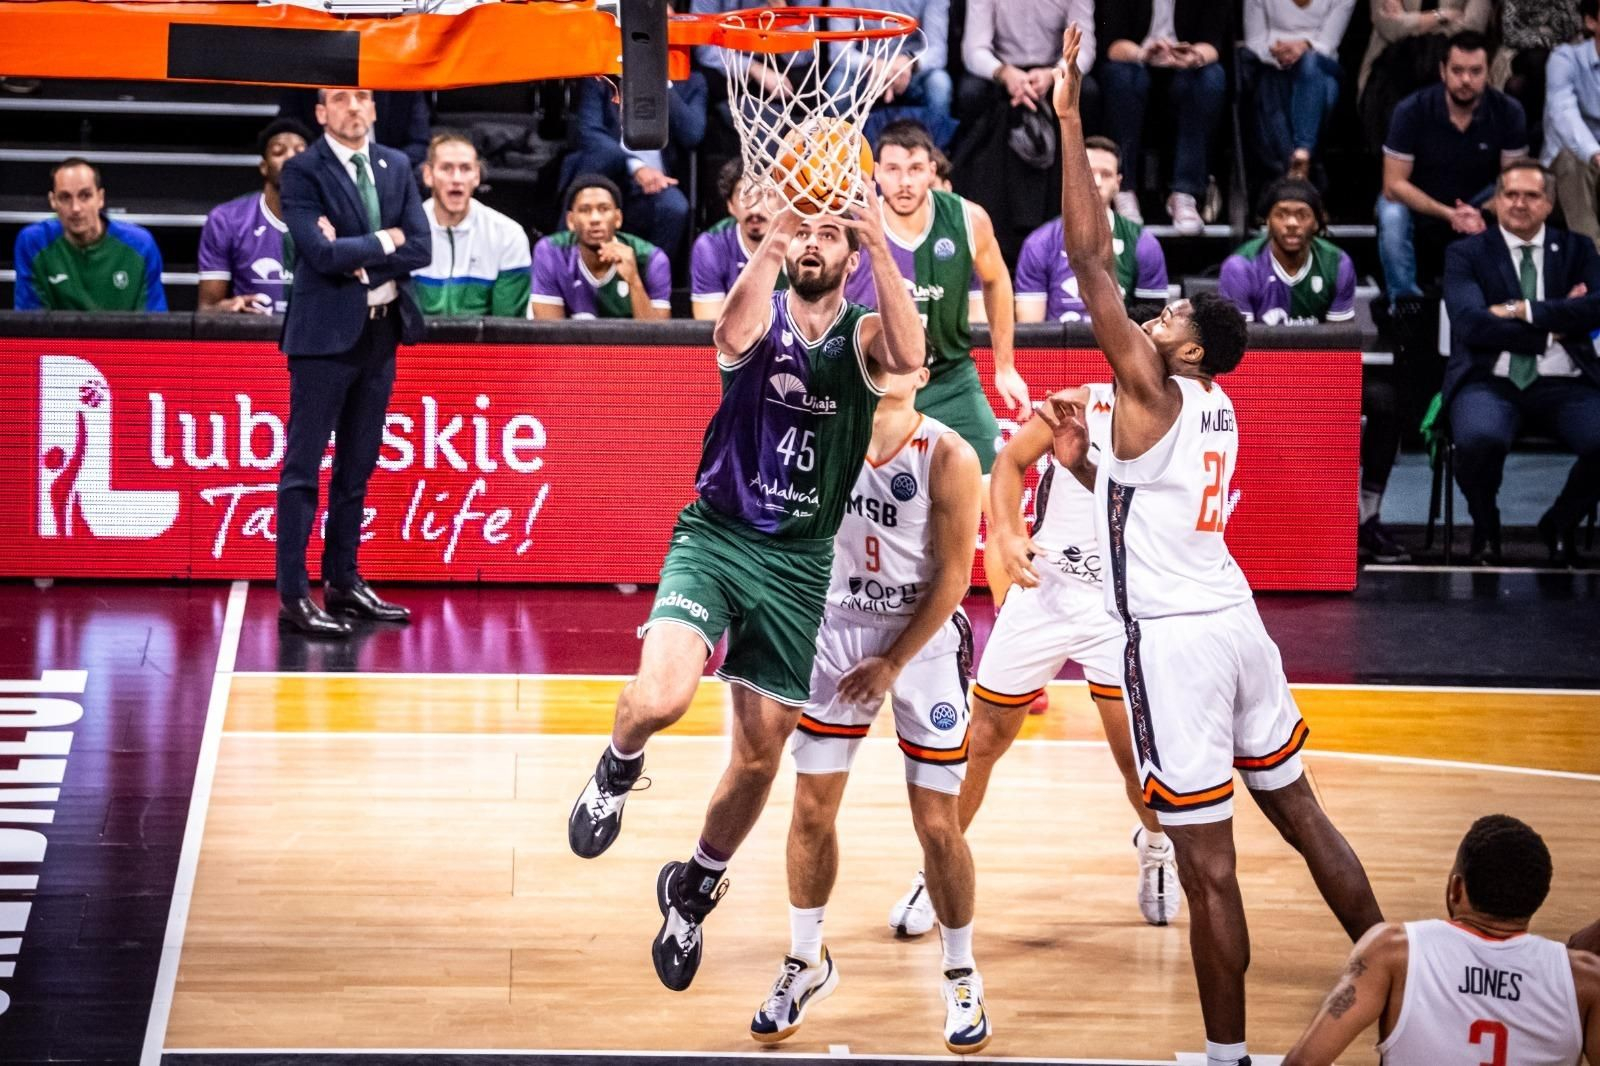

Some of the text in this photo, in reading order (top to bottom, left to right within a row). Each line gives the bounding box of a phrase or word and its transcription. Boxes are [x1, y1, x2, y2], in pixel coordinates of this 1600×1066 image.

[148, 392, 547, 473] lubskie
[776, 426, 816, 472] 45
[402, 478, 550, 564] life!
[846, 494, 899, 528] MSB
[866, 535, 881, 573] 9
[1458, 965, 1523, 1002] JONES
